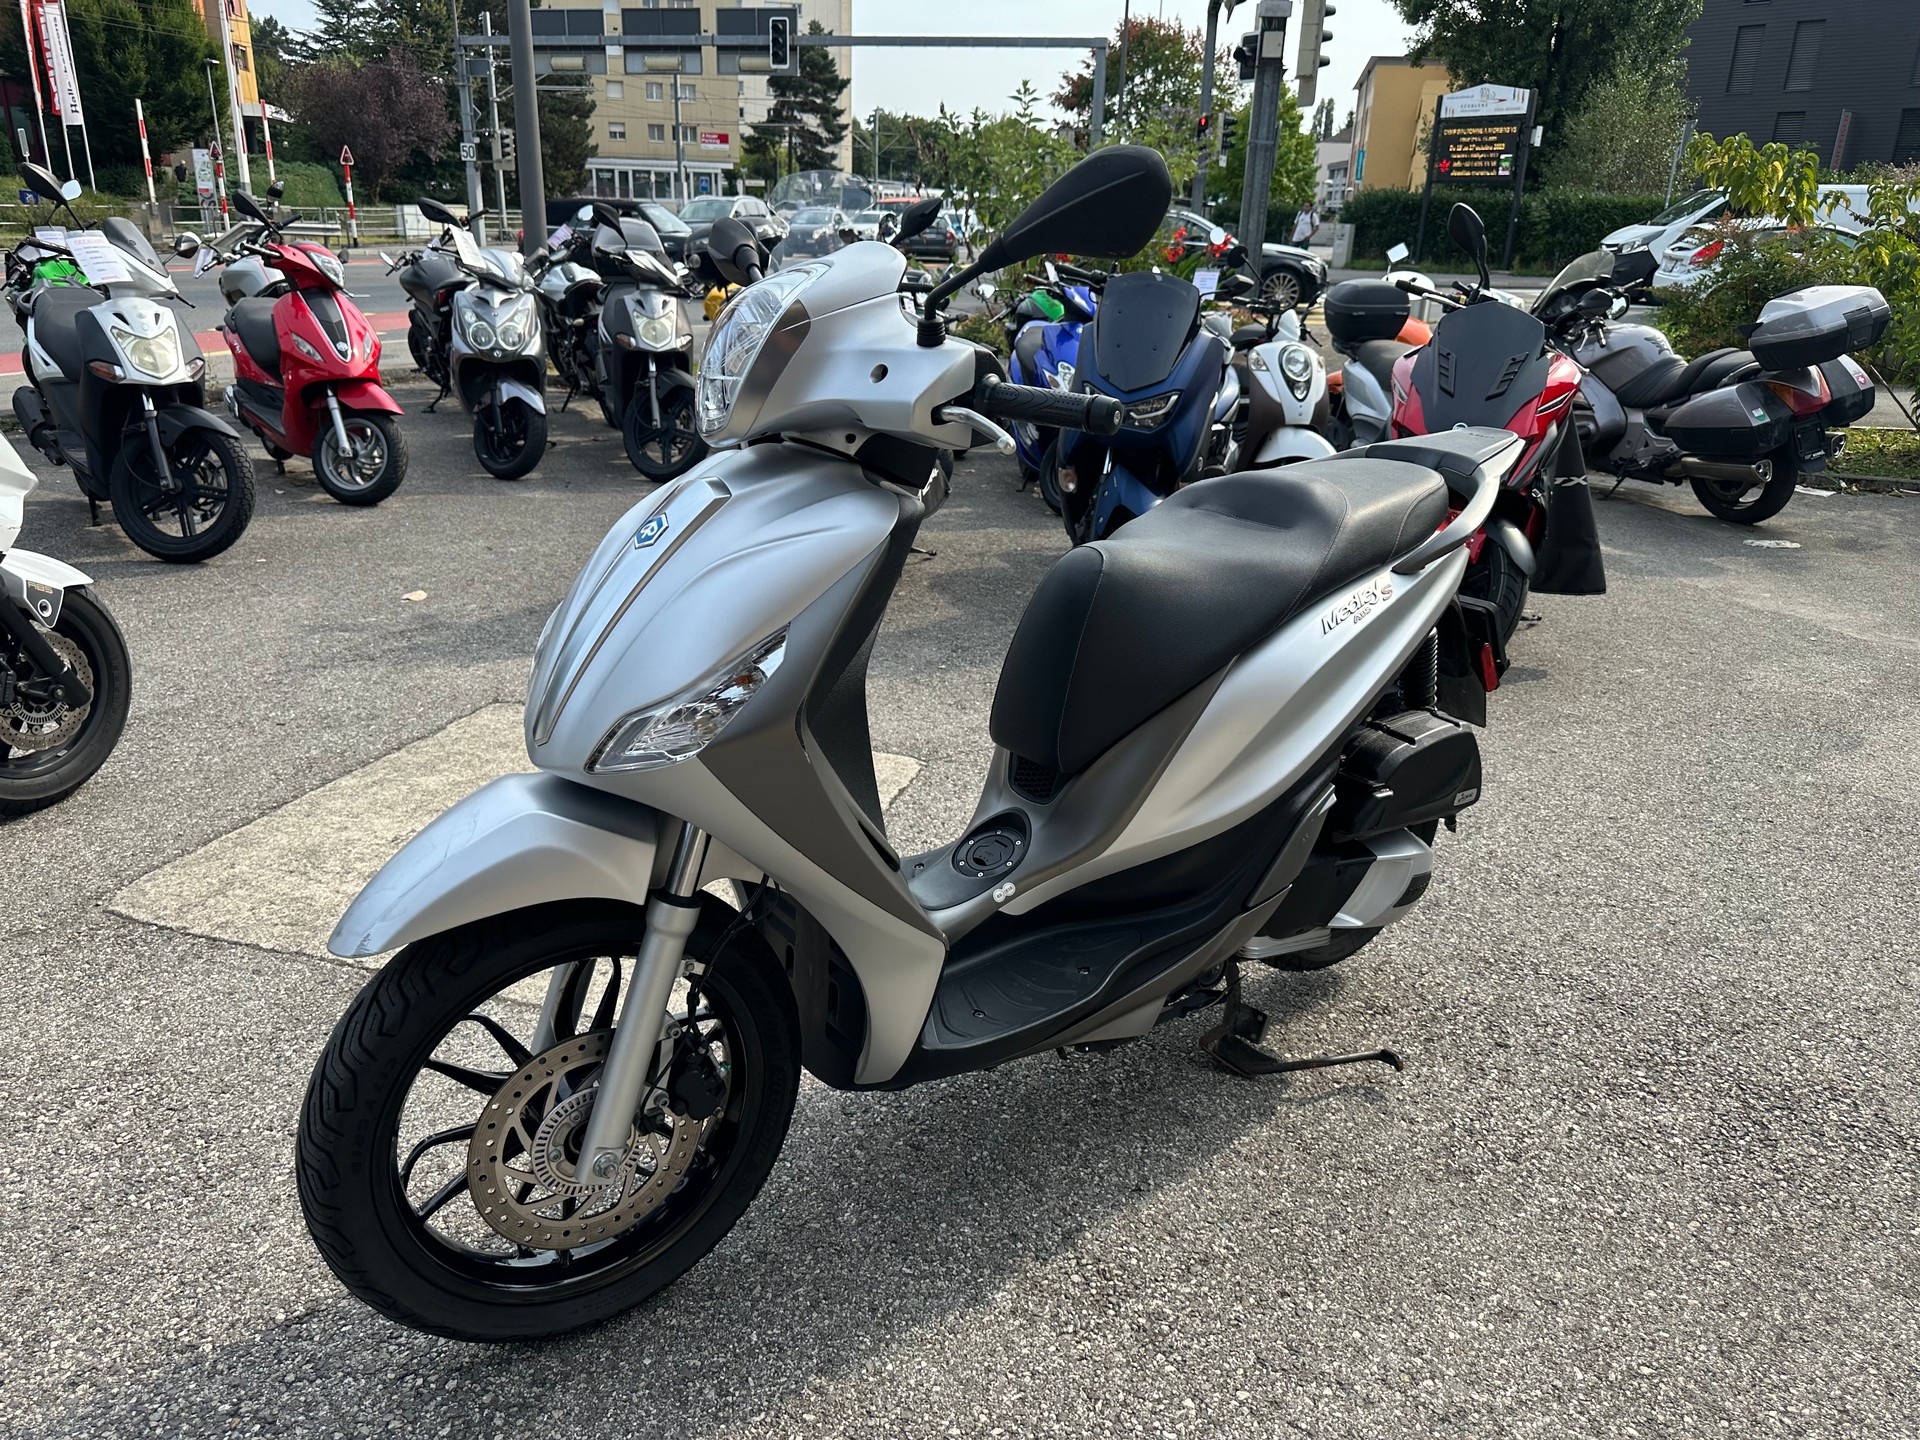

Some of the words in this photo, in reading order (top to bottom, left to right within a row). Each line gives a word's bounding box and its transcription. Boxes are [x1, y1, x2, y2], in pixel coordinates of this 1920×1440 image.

[462, 145, 475, 159] 50
[1321, 580, 1379, 635] Medley
[1353, 606, 1372, 624] ABS
